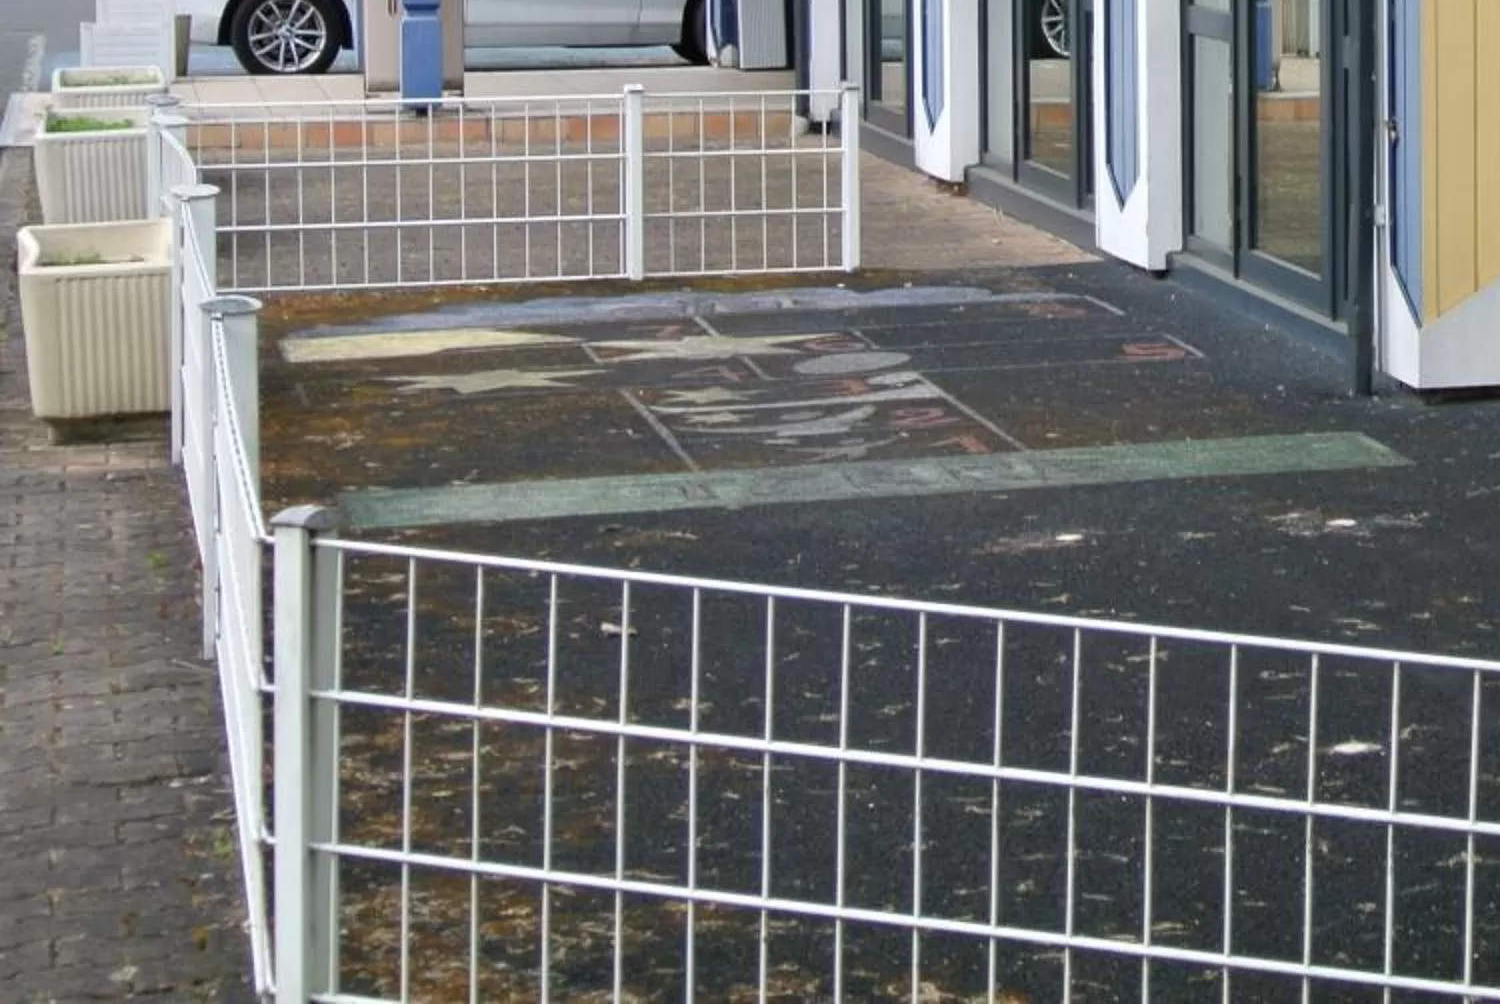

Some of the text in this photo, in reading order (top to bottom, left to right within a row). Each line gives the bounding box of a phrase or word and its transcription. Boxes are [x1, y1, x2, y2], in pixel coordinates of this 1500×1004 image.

[1118, 343, 1187, 361] 5
[672, 364, 744, 383] 4
[889, 407, 961, 428] 2
[927, 436, 995, 453] 1
